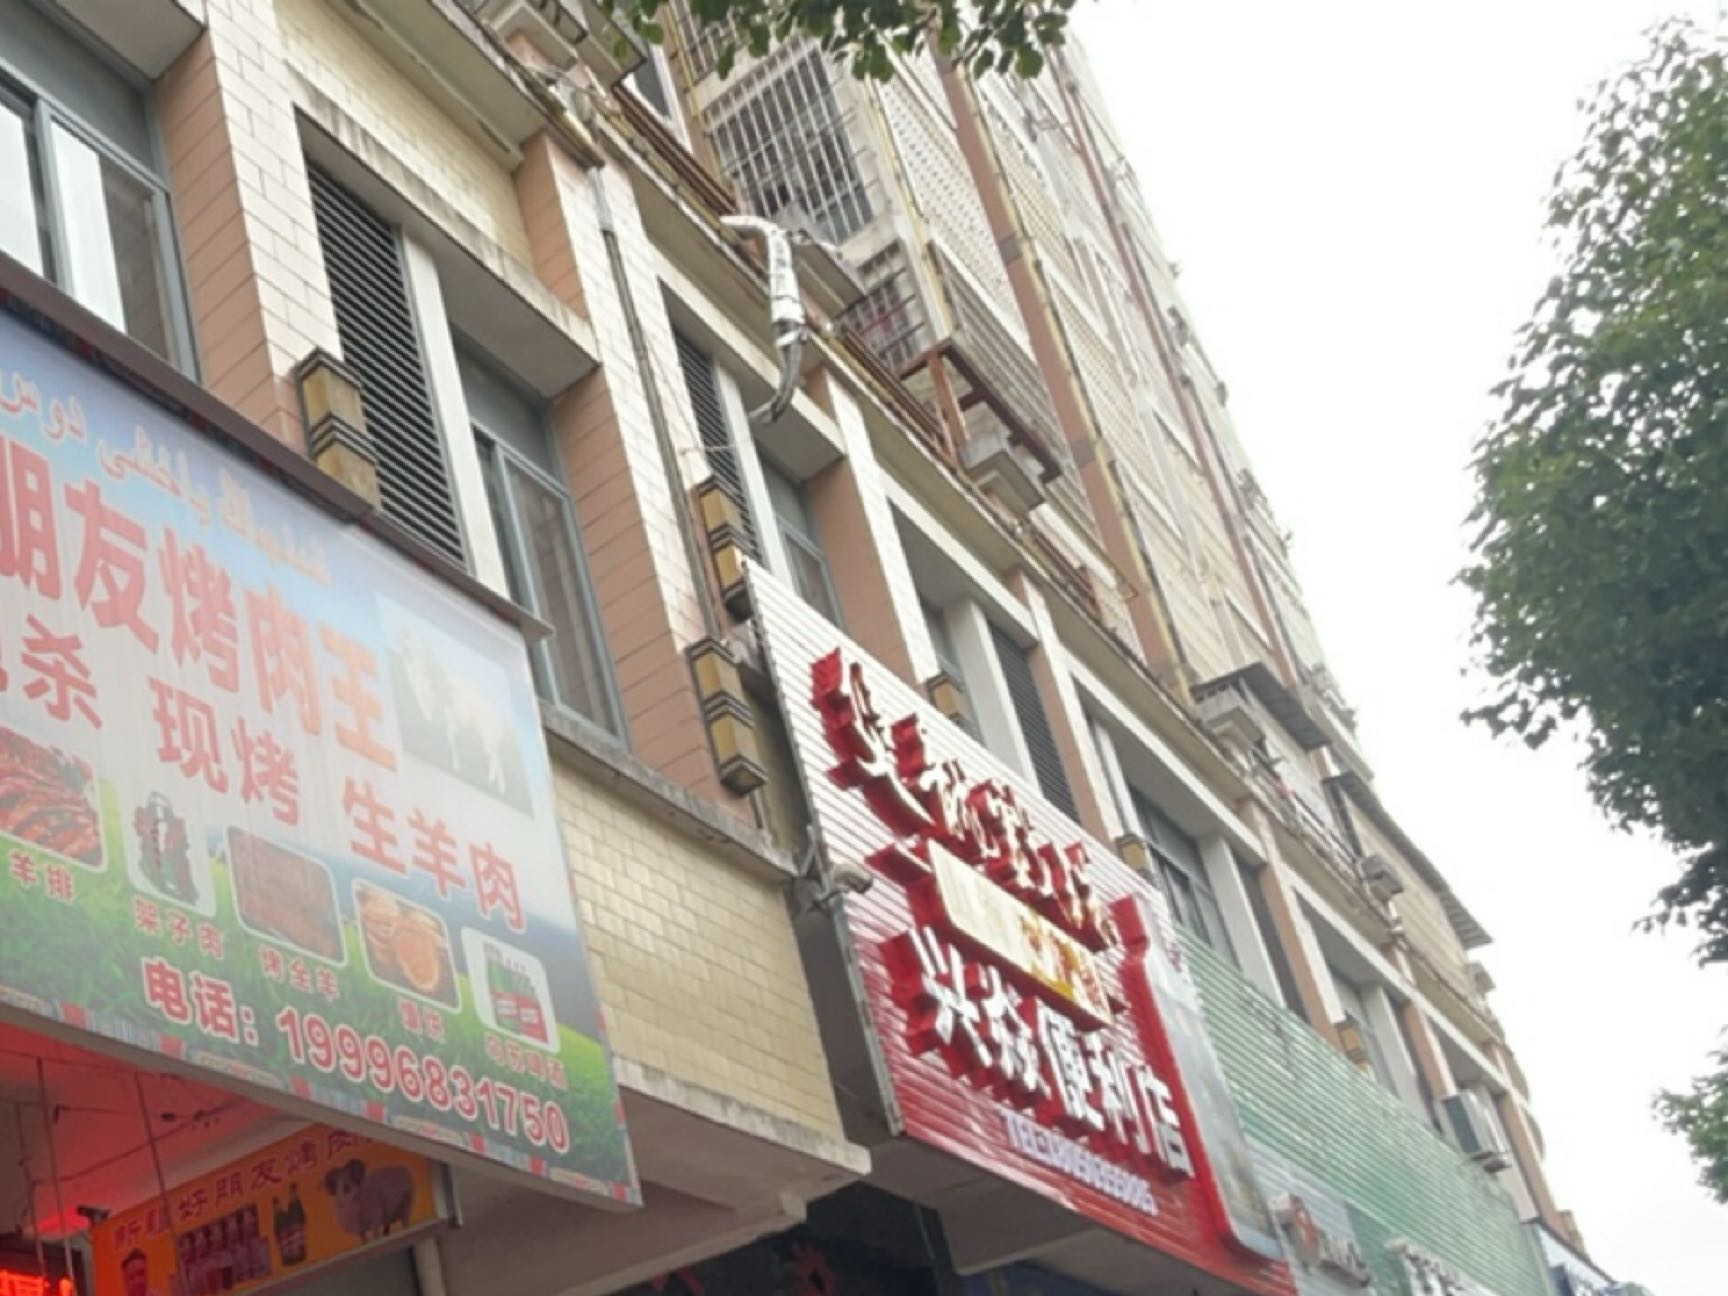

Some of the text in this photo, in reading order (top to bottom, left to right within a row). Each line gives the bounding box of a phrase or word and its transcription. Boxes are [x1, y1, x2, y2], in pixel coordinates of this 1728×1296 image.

[149, 675, 300, 828] 现烤
[341, 776, 525, 934] 生羊肉
[113, 1129, 372, 1249] 新疆好朋友烤肉
